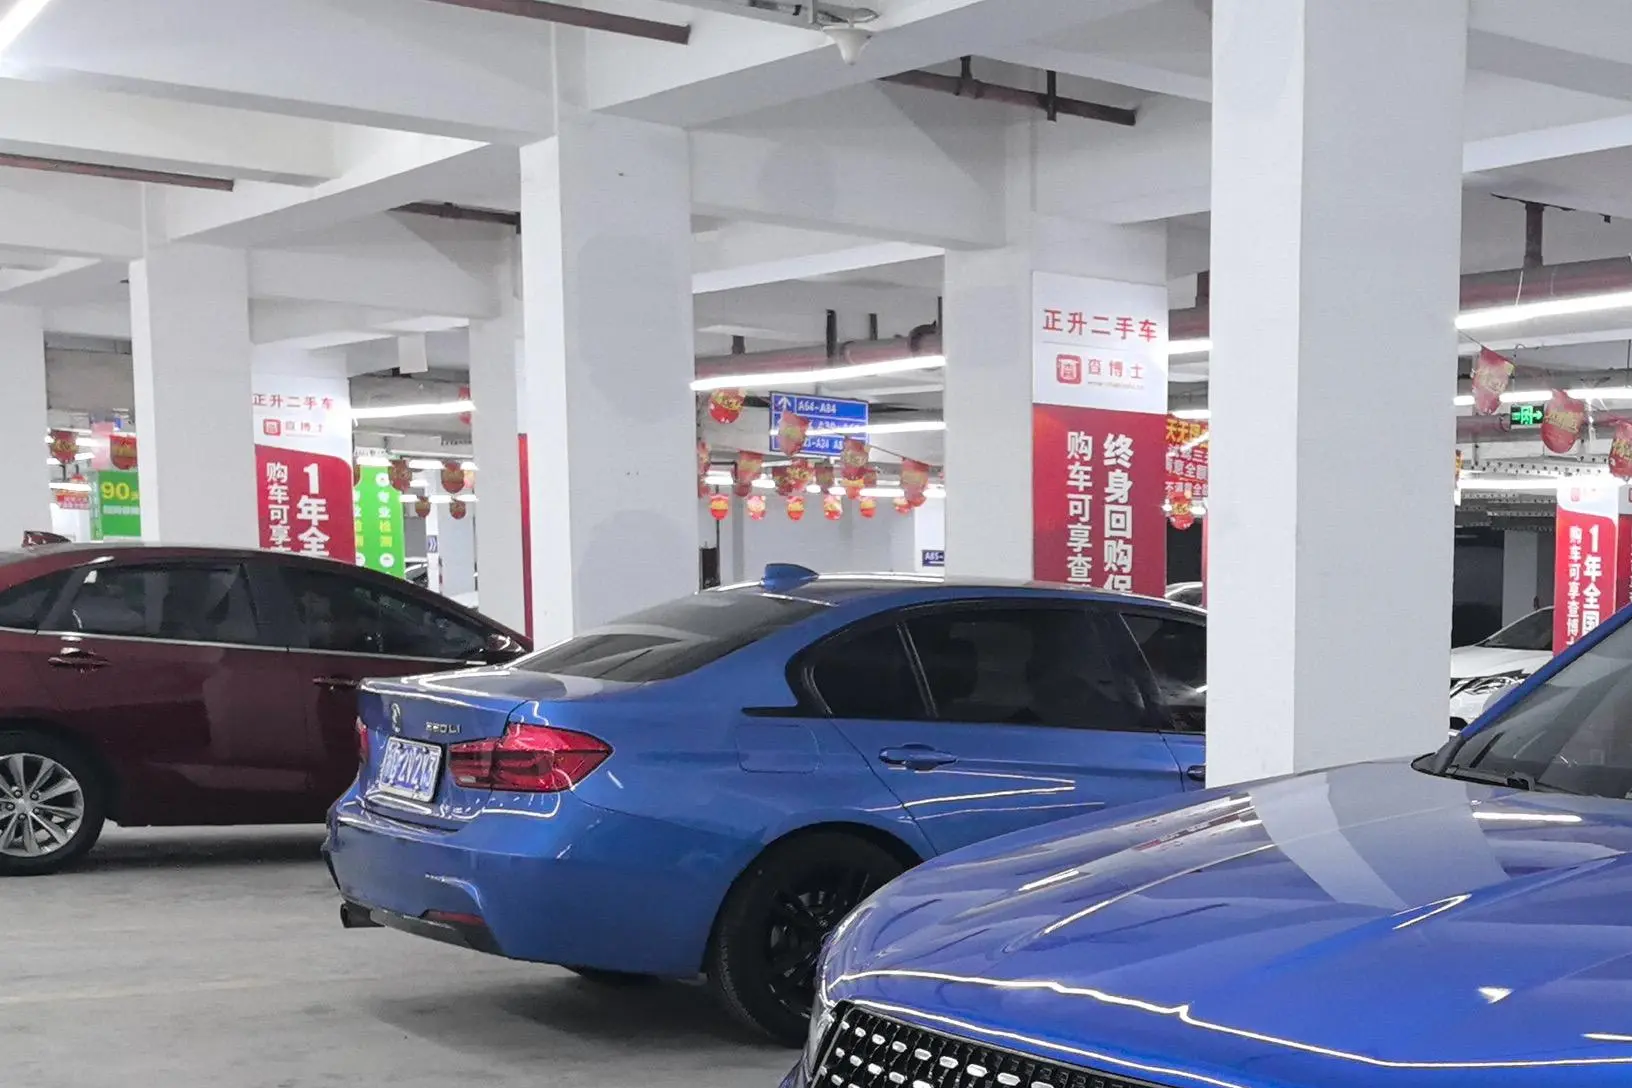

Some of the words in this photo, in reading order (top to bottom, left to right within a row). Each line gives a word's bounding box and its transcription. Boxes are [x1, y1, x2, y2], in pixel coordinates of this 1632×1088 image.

[1042, 308, 1157, 342] 正升二手车
[266, 462, 291, 552] 购车可享
[1066, 431, 1093, 588] 购车可享查
